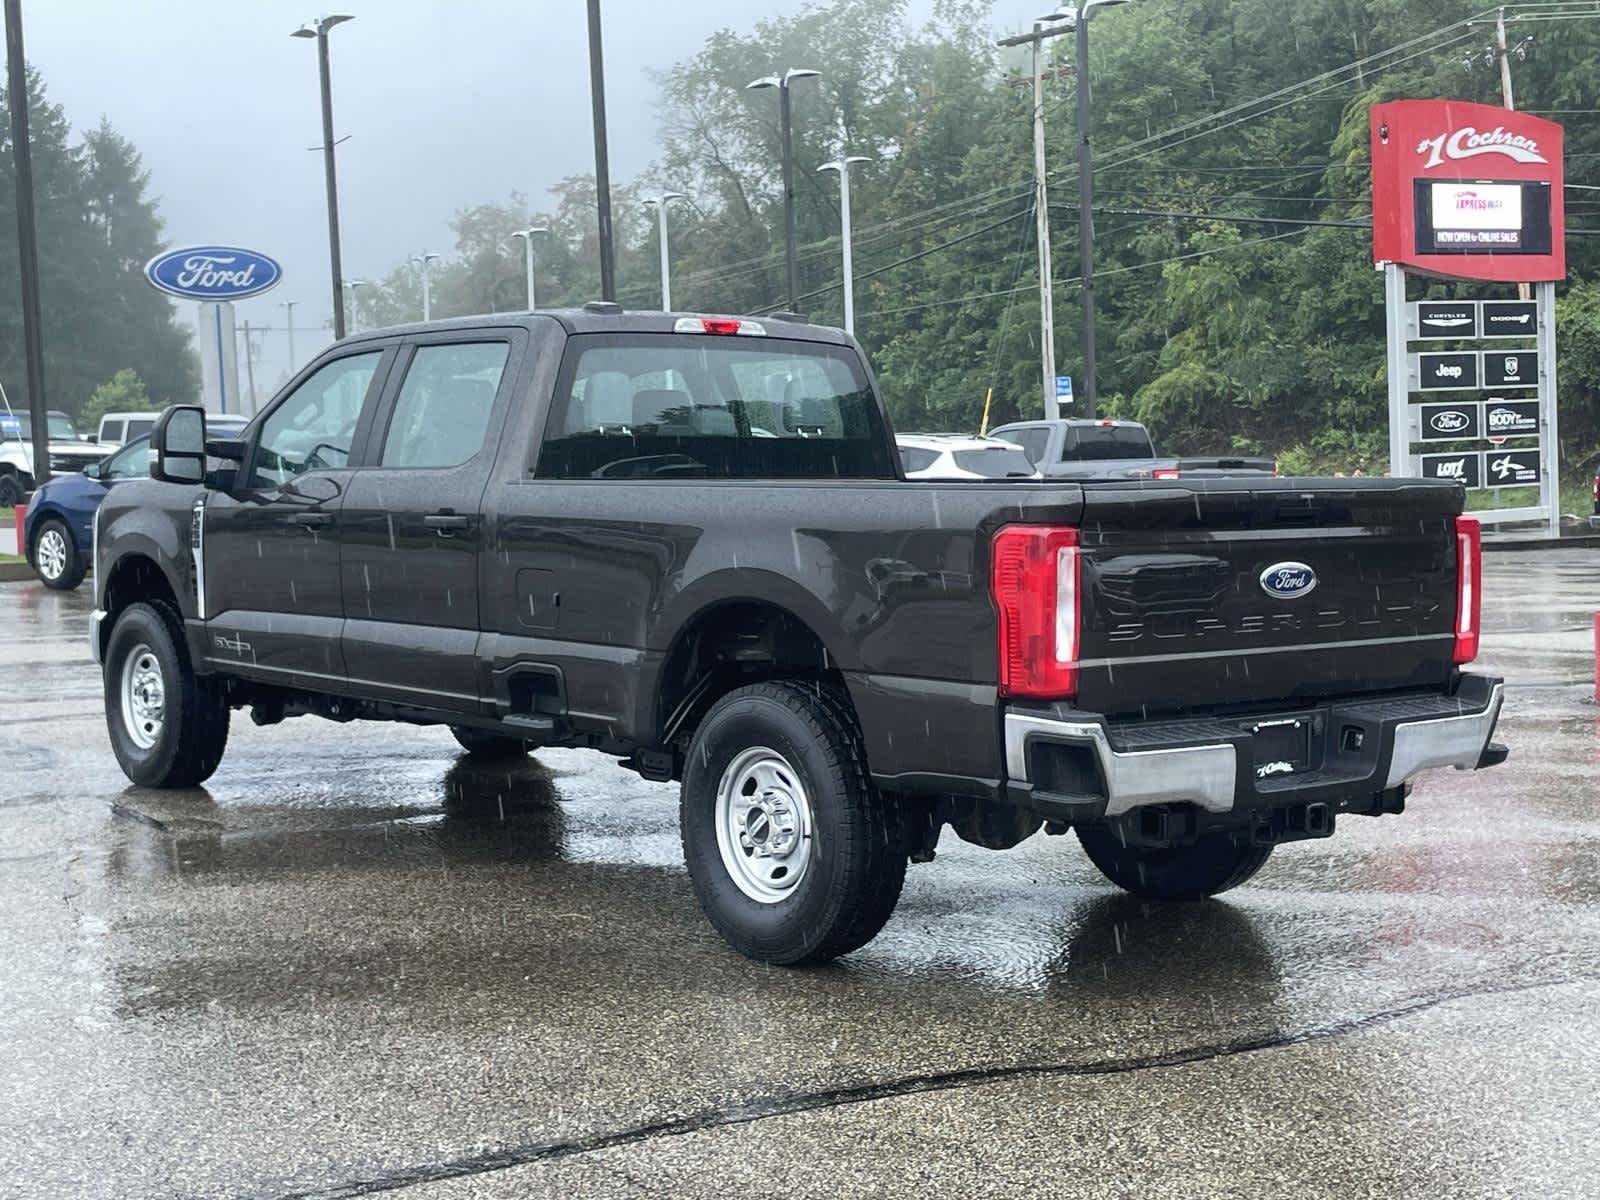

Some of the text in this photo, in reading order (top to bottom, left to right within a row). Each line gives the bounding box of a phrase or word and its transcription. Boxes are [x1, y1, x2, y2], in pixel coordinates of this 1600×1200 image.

[1416, 126, 1549, 169] #1 Cochran
[177, 255, 256, 288] Ford
[1435, 363, 1462, 379] Jeep
[1437, 413, 1463, 428] Ford
[1489, 413, 1516, 427] BODY
[1275, 569, 1306, 589] Ford
[1108, 613, 1302, 643] SUPER
